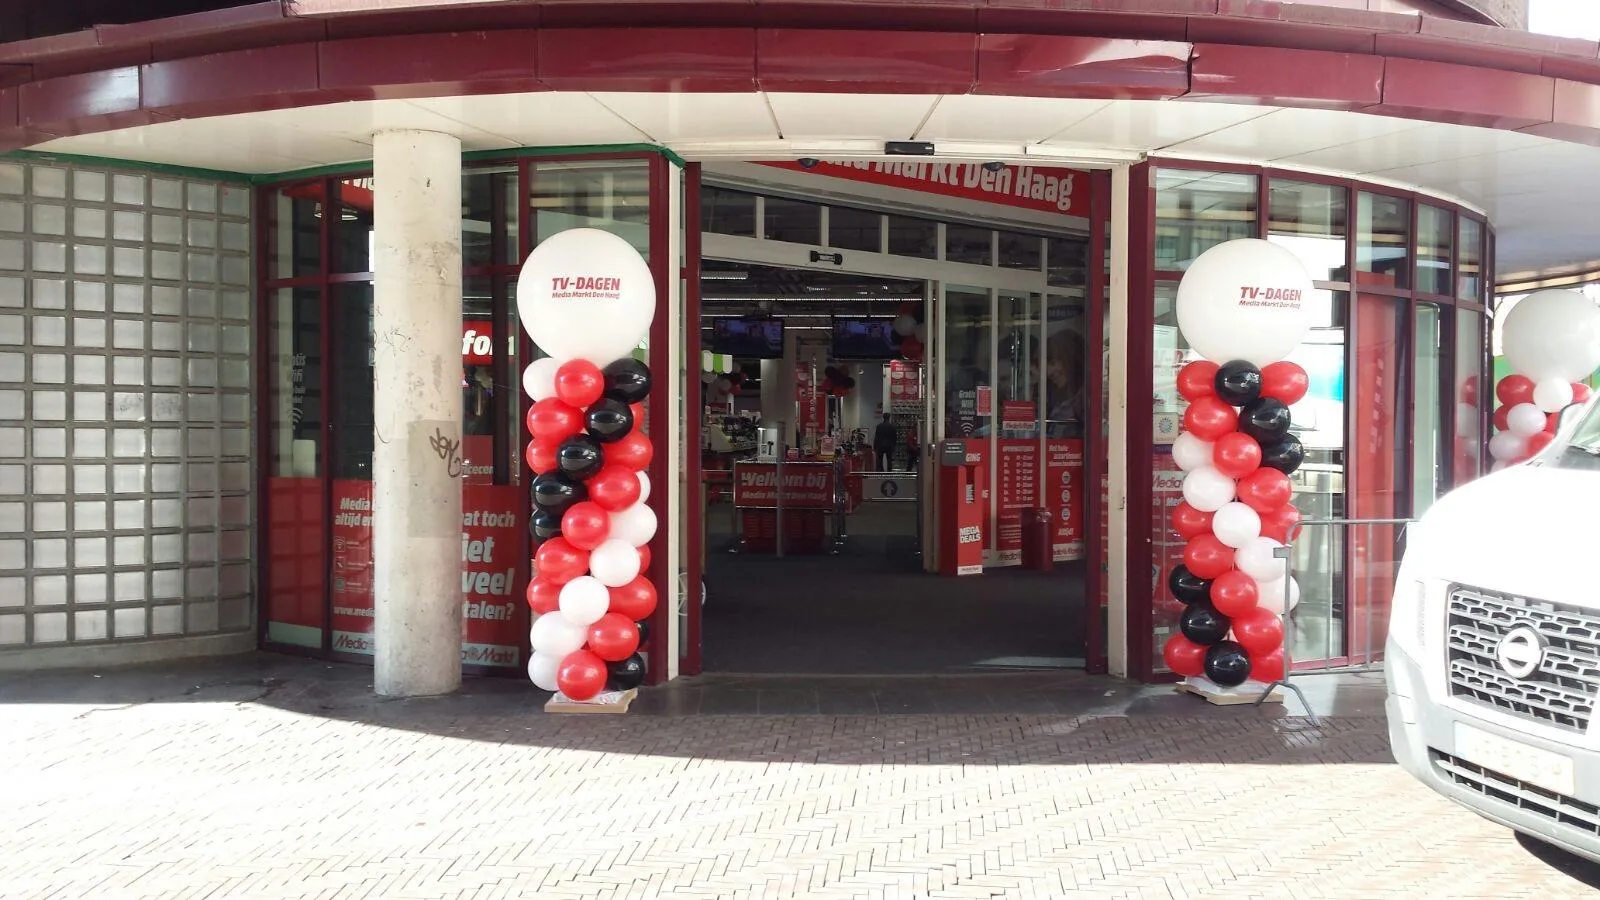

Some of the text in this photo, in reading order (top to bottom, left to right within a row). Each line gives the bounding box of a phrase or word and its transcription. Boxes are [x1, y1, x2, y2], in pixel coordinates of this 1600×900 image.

[963, 162, 1012, 195] Den
[1015, 165, 1075, 211] Haag
[552, 277, 621, 291] TV-DAGEN
[1240, 286, 1302, 302] TV-DAGEN
[1239, 299, 1260, 307] Media
[741, 472, 828, 490] Welkm bij
[340, 498, 370, 510] Media
[335, 513, 361, 527] altijd
[462, 510, 516, 528] at toch
[461, 532, 495, 563] iet
[960, 534, 981, 544] DEALS
[461, 567, 515, 595] veel
[462, 600, 515, 621] talen?
[477, 647, 514, 664] Markt
